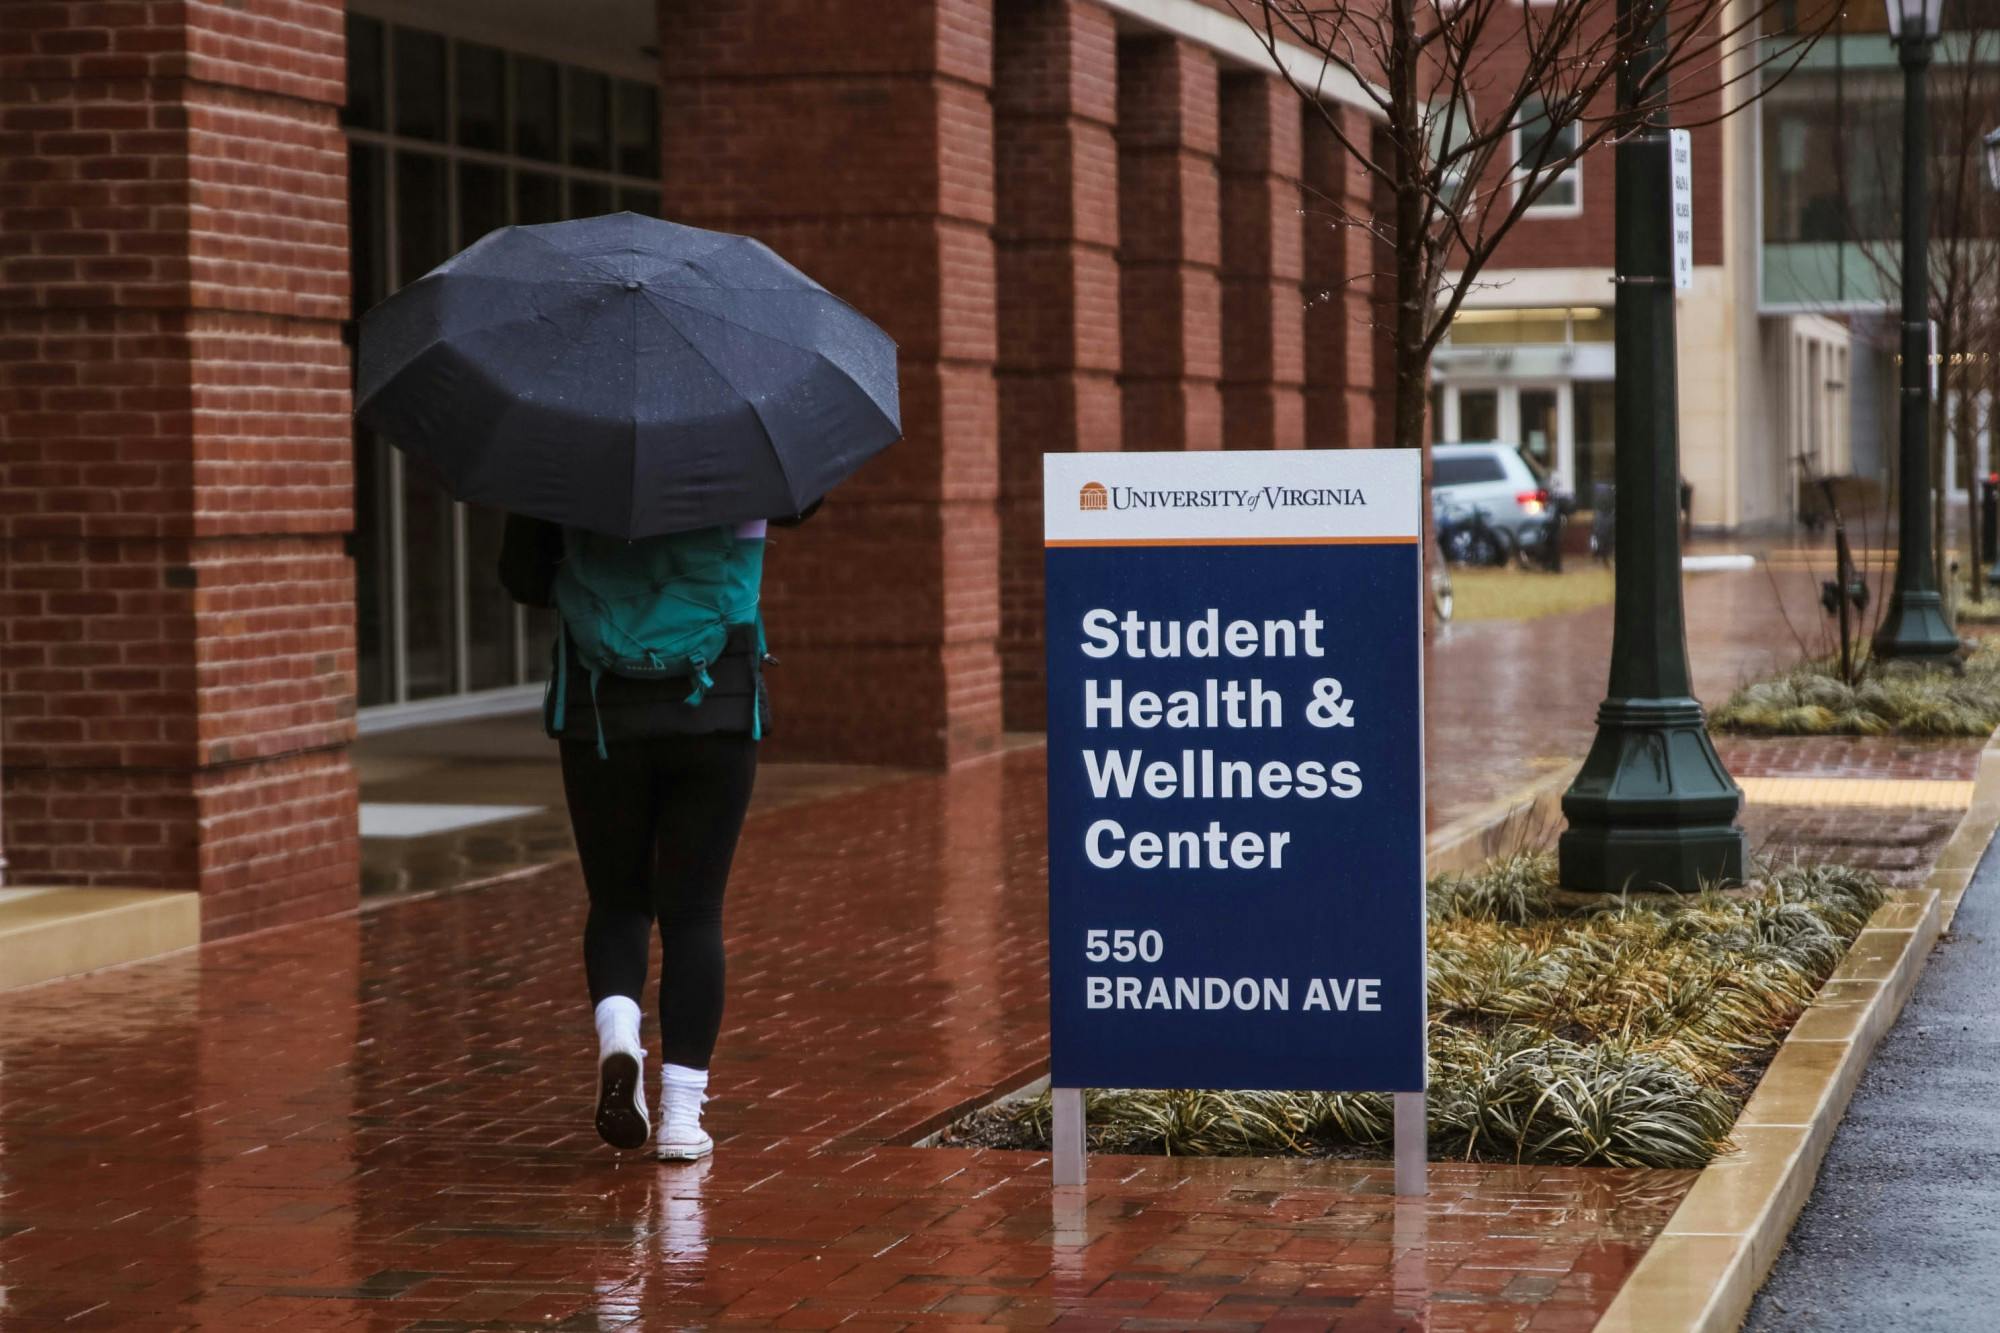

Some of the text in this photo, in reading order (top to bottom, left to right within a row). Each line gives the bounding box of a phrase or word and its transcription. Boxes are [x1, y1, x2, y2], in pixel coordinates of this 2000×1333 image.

[1112, 487, 1366, 511] UNIVERSITY of VIRGINIA
[1081, 609, 1324, 658] Student
[1086, 678, 1354, 728] Health &
[1083, 750, 1362, 798] Wellness
[1085, 820, 1290, 869] Center
[1086, 930, 1163, 962] 550
[1087, 977, 1381, 1011] BRANDON AVE
